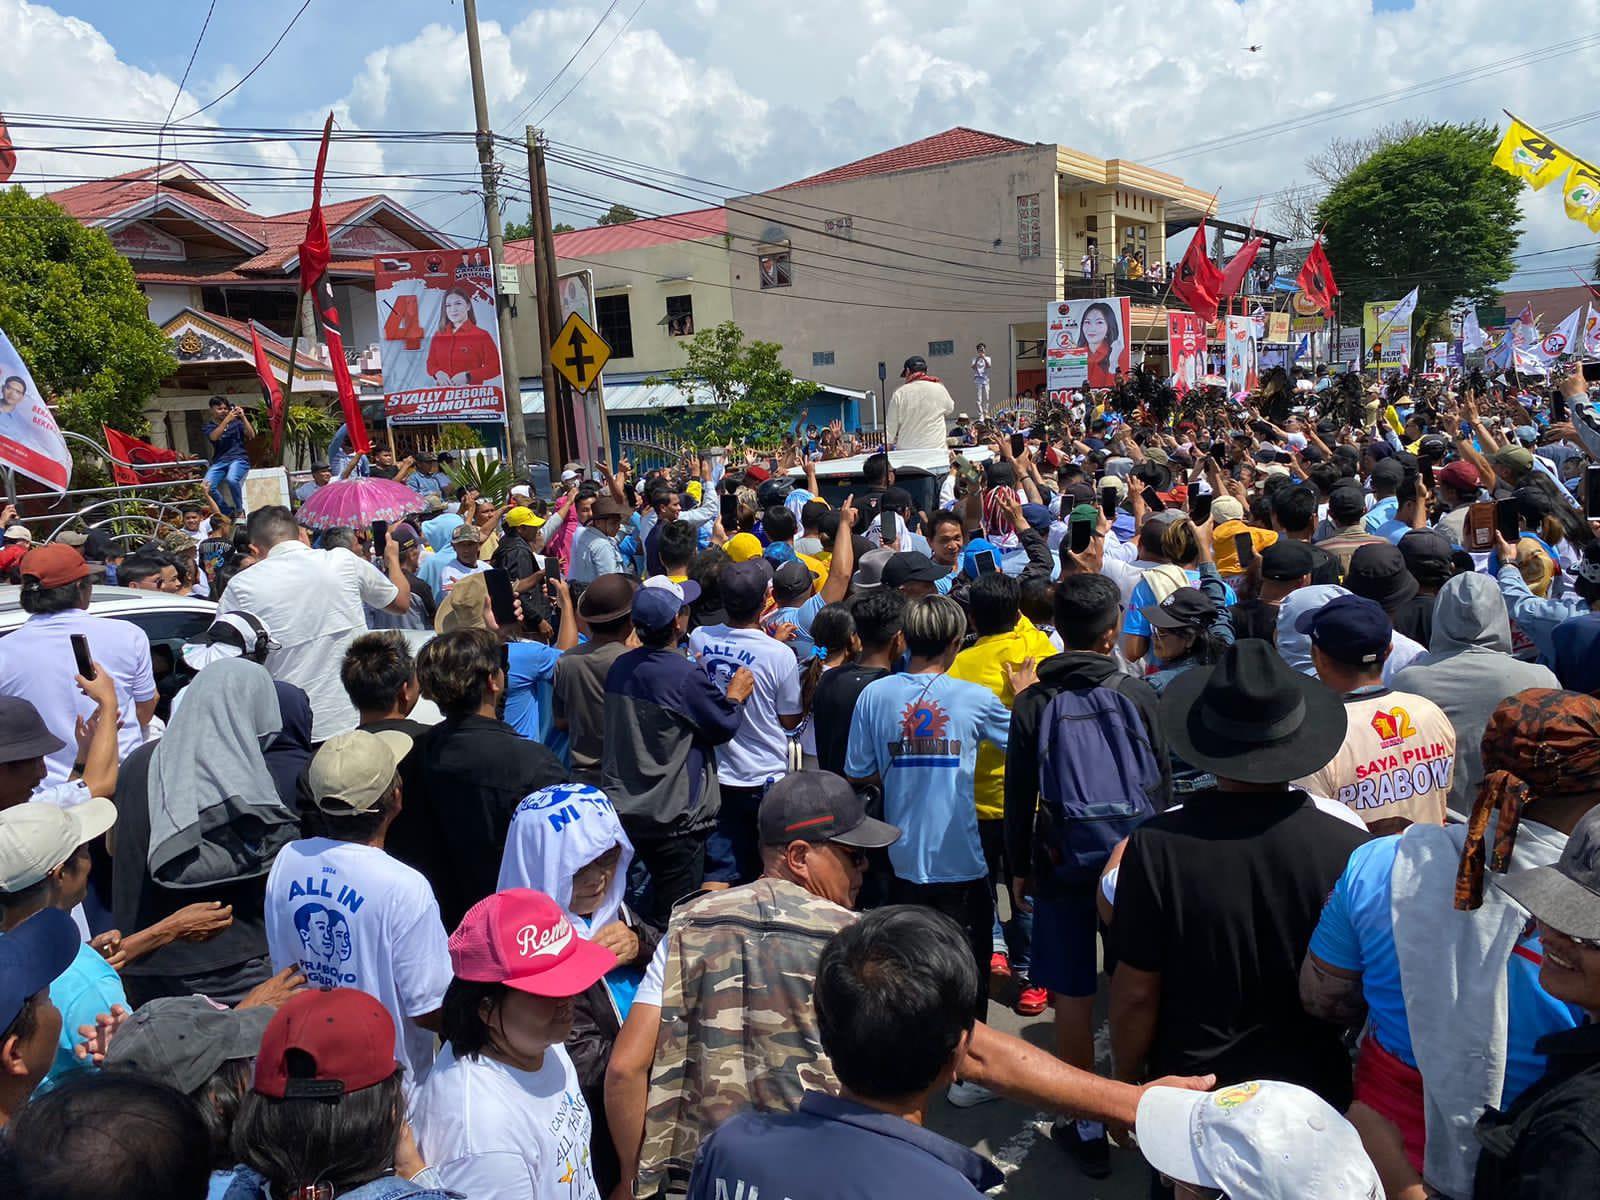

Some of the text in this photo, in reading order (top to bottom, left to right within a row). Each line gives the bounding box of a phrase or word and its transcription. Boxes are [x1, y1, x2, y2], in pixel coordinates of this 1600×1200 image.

[1520, 138, 1557, 161] 4
[384, 295, 425, 350] 4
[387, 386, 495, 407] SYALLY DEBORA
[416, 396, 499, 414] SUMOLANG
[703, 645, 756, 666] ALL IN
[914, 708, 934, 736] 2
[1389, 706, 1416, 738] 2
[1356, 755, 1398, 779] SAYA
[1402, 743, 1446, 765] PILIH
[289, 877, 365, 914] ALL IN
[567, 1092, 586, 1137] THING
